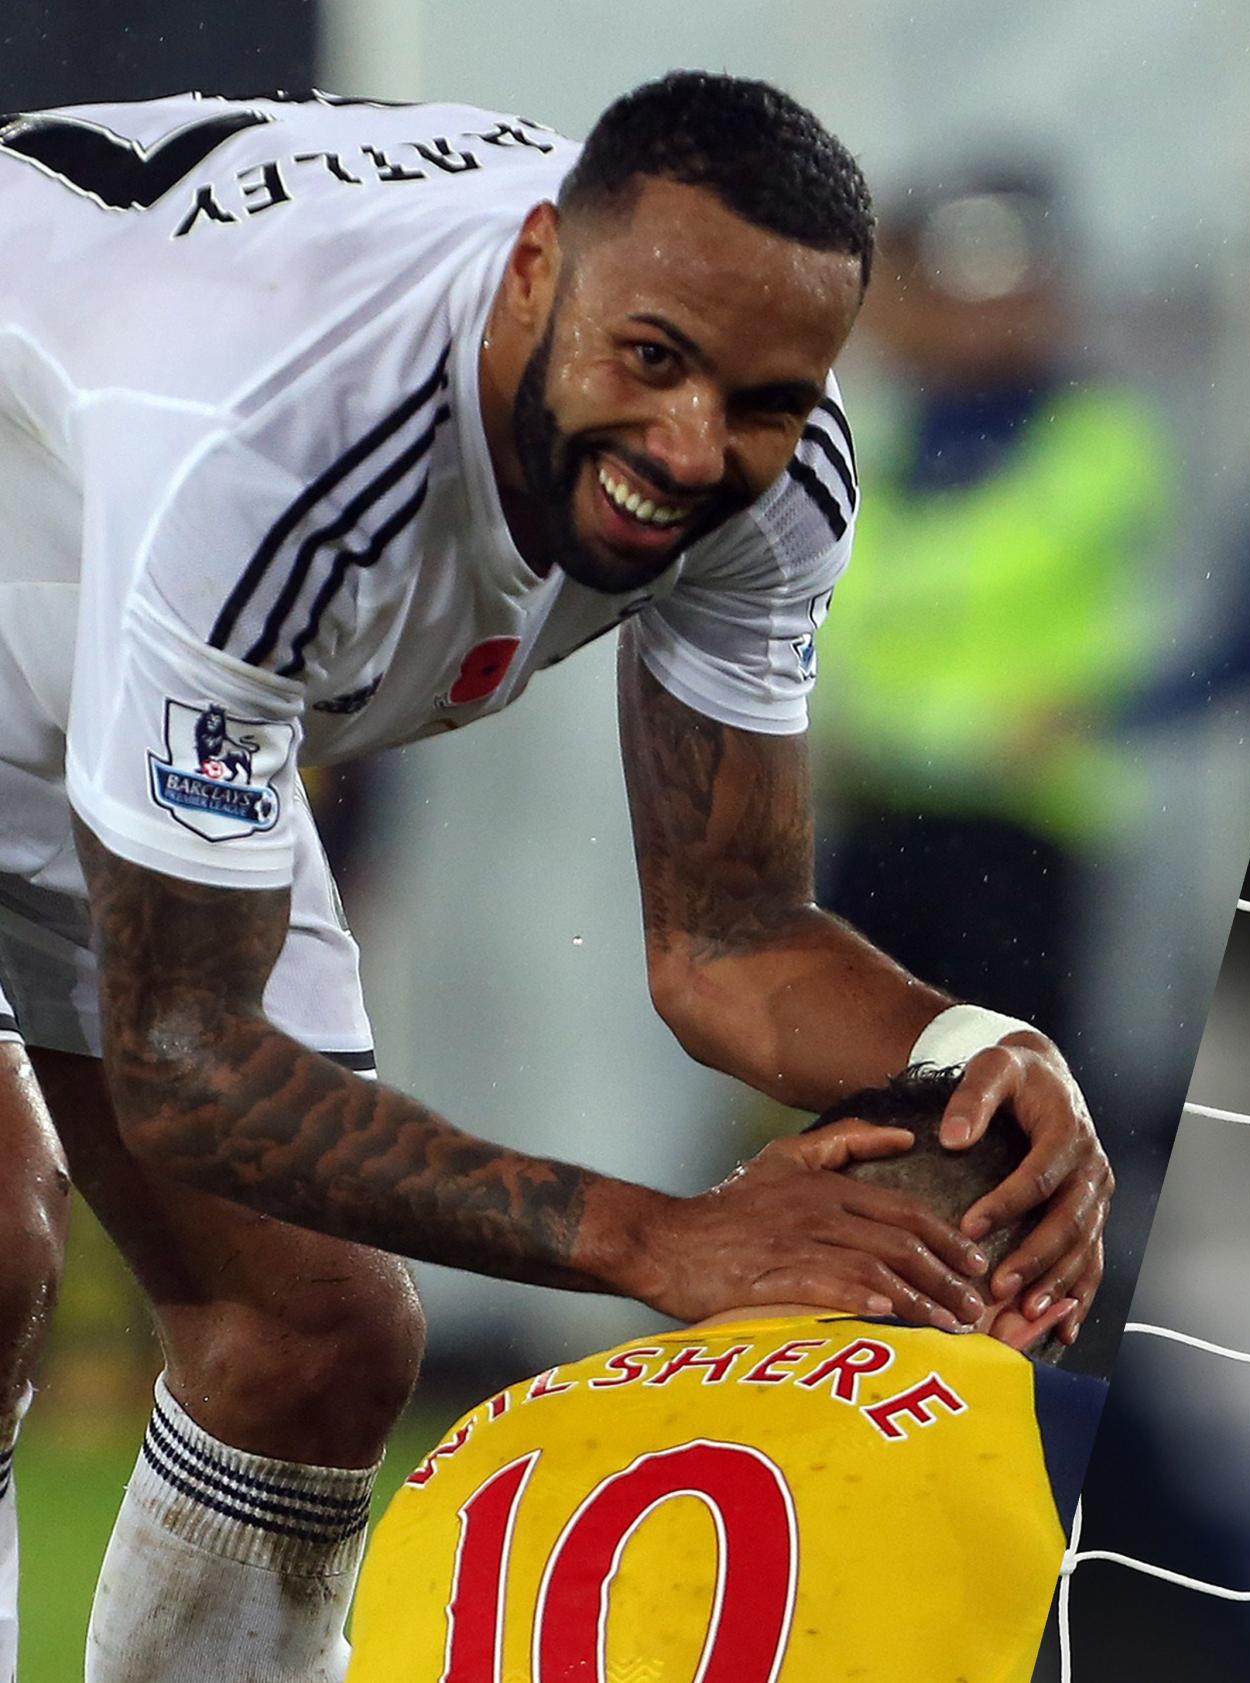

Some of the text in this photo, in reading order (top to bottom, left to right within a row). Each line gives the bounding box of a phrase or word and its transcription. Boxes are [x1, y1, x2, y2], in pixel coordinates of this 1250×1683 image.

[171, 116, 555, 238] ARTLEY
[166, 774, 250, 806] BARCLAYS
[209, 799, 247, 816] LEAGUE
[404, 1338, 968, 1488] WILSHERE
[438, 1438, 800, 1683] 10
